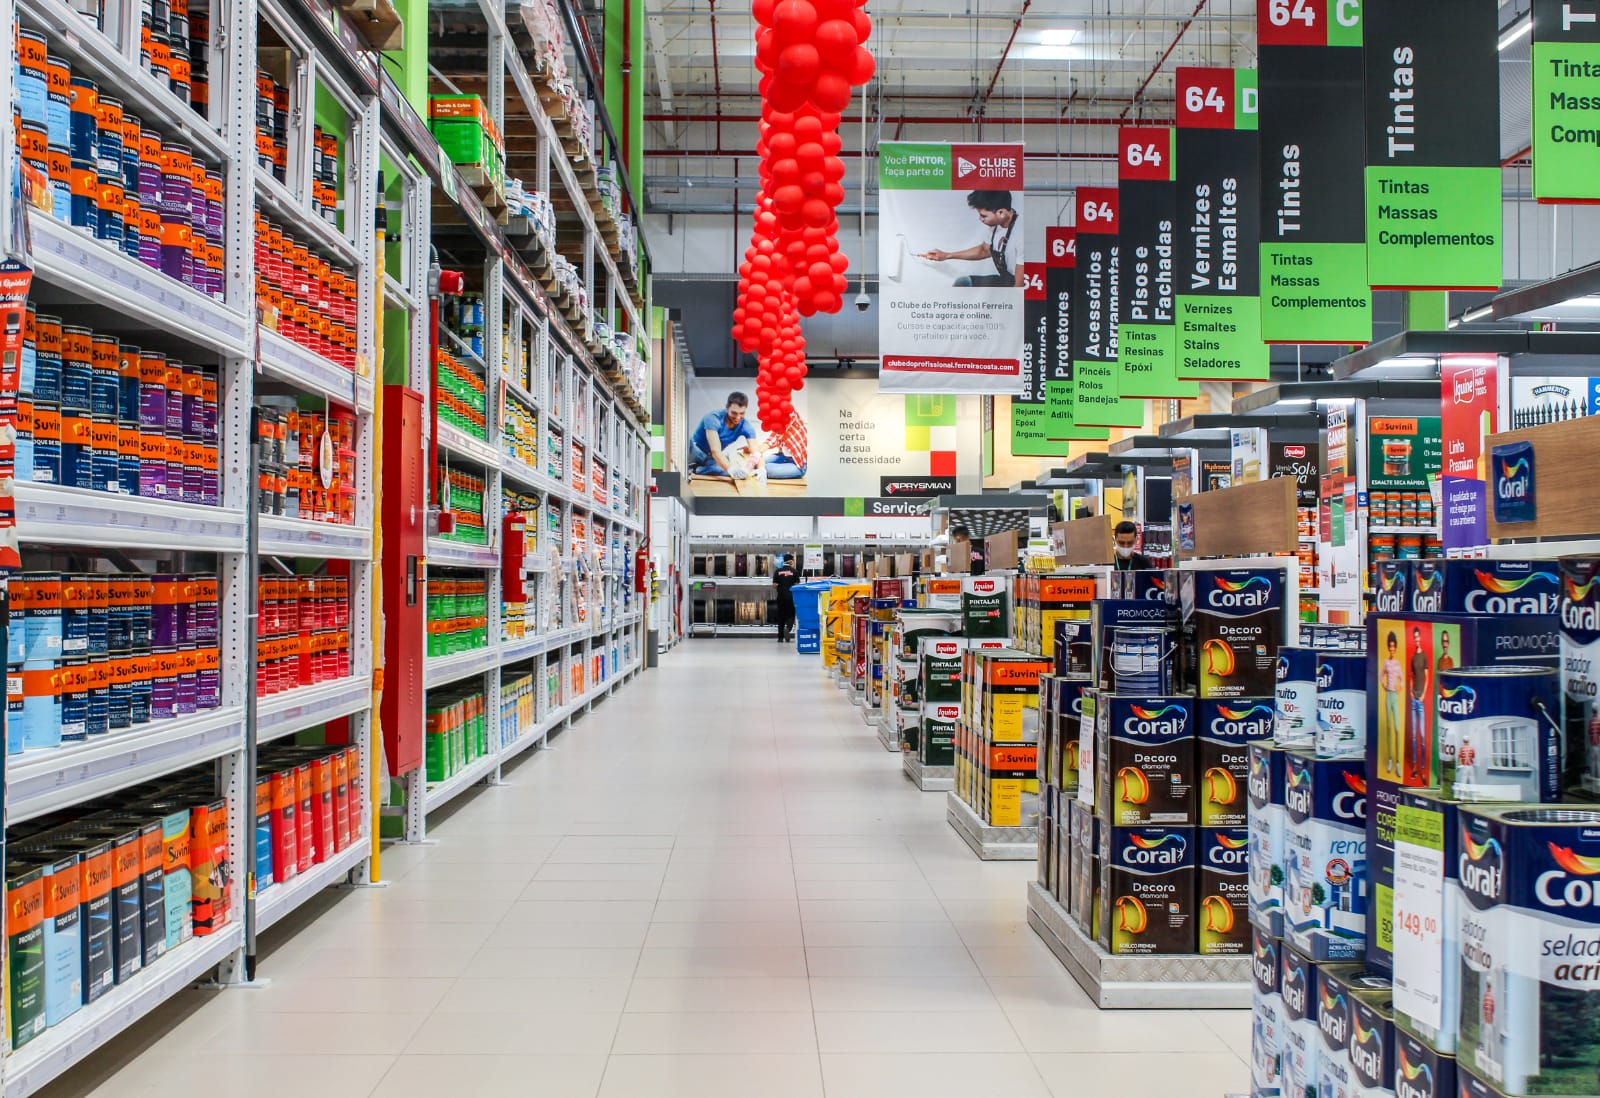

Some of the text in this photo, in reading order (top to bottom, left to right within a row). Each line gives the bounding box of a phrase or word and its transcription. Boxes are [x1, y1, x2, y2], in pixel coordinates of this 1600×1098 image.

[1269, 0, 1359, 27] 64 C
[1185, 86, 1259, 113] 64 D
[1386, 46, 1415, 157] Tintas
[884, 155, 947, 167] Você PINTOR,
[979, 158, 1016, 168] CLUBE
[1127, 143, 1161, 167] 64
[884, 166, 944, 178] faça parte do
[979, 166, 1016, 178] online
[1278, 144, 1300, 236] Tintas
[1378, 179, 1430, 194] Tintas
[1083, 201, 1114, 222] 64
[1378, 206, 1438, 220] Massas
[1190, 183, 1211, 290] Vernizes
[1217, 176, 1237, 291] Esmaltes
[1378, 230, 1495, 249] Complementos
[1053, 239, 1076, 257] 64
[1271, 253, 1313, 266] Tintas
[1155, 219, 1172, 321] Fachadas
[1131, 245, 1148, 321] Pisos e
[1271, 275, 1320, 287] Massas
[897, 301, 920, 309] Clube
[982, 302, 1013, 310] Ferreira
[1085, 251, 1102, 357] Acessórios
[1105, 246, 1119, 358] Ferramentas
[1184, 303, 1233, 315] Vernizes
[1271, 296, 1367, 310] Complementos
[911, 311, 934, 319] Costa
[935, 312, 958, 320] agora
[966, 312, 992, 320] online.
[1055, 291, 1069, 377] Protetores
[1183, 321, 1237, 333] Esmaltes
[1125, 331, 1157, 341] Tintas
[1125, 346, 1164, 356] Resinas
[1183, 339, 1220, 350] Stains
[1125, 362, 1153, 374] Epóxi
[1183, 357, 1241, 369] Seladores
[1079, 367, 1111, 376] Pincéis
[1079, 381, 1103, 389] Rolos
[1454, 373, 1474, 397] Iquine
[1079, 394, 1119, 405] Bandejas
[839, 409, 852, 418] Na
[839, 421, 875, 430] medida
[1015, 419, 1036, 428] Epóxi
[1385, 423, 1413, 431] Suvinil
[839, 433, 866, 441] certa
[839, 444, 871, 453] da sua
[1449, 441, 1465, 455] Linha
[839, 455, 901, 464] necessidade
[1449, 457, 1474, 473] Premium
[1291, 461, 1317, 476] Sol &
[1499, 476, 1526, 499] Coral
[974, 582, 994, 591] Iquine
[1057, 586, 1089, 595] Suvinil
[1208, 589, 1263, 607] Coral
[1377, 591, 1400, 613] Coral
[1413, 591, 1437, 613] Coral
[1464, 589, 1549, 614] Coral
[1562, 598, 1600, 631] Coral
[1219, 626, 1262, 635] Decora
[936, 644, 957, 653] Iquine
[1495, 633, 1560, 652] PROMOÇÃO
[938, 707, 958, 717] Iquine
[1123, 717, 1179, 736] Coral
[1210, 717, 1266, 736] Coral
[1134, 754, 1177, 763] Decora
[1249, 770, 1266, 801] Coral
[1285, 782, 1308, 814] Coral
[168, 842, 191, 863] Suvinil
[1123, 846, 1177, 864] Coral
[92, 866, 111, 886] Suvinil
[1459, 855, 1496, 898] Coral
[60, 880, 79, 900] Suvinil
[1132, 882, 1176, 892] Decora
[1254, 953, 1272, 987] Coral
[1282, 976, 1301, 1012] Coral
[1319, 1003, 1343, 1043] Coral
[1351, 1036, 1377, 1080] Coral
[1396, 1067, 1426, 1098] Coral
